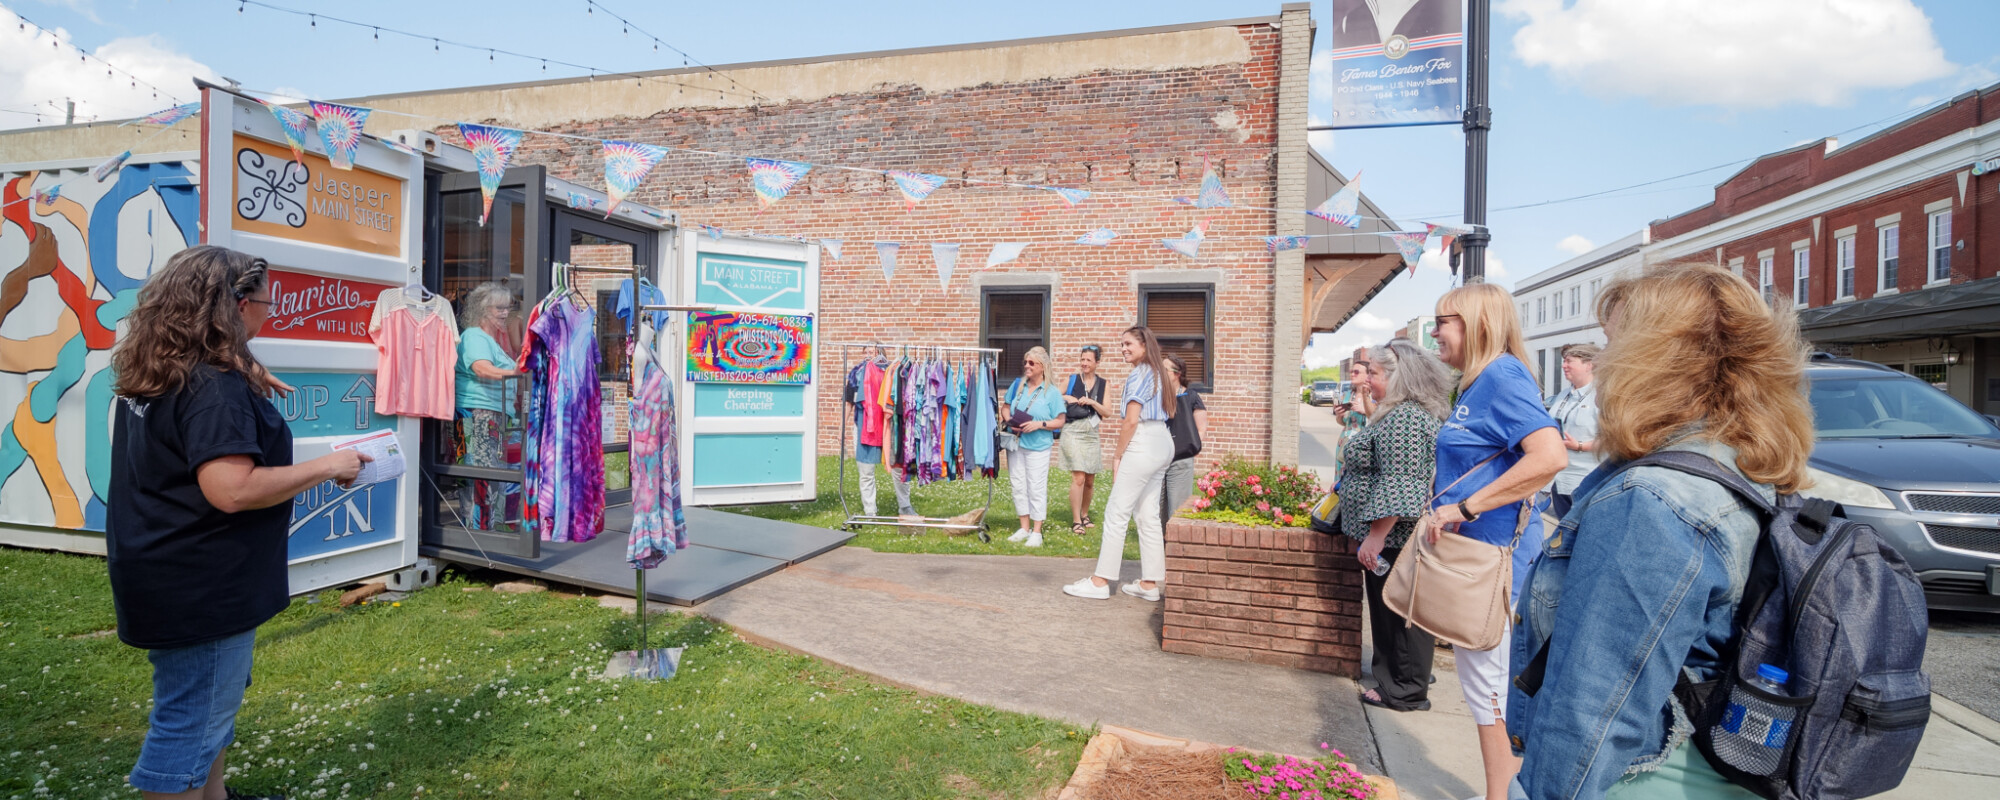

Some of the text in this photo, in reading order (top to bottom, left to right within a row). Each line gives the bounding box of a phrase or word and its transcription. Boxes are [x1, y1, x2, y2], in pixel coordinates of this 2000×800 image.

[1341, 58, 1452, 83] James Benton Fox
[1406, 79, 1425, 90] Navy
[1426, 76, 1458, 86] Seabees
[313, 172, 391, 209] Jasper
[312, 197, 395, 233] MAIN STREET
[714, 266, 792, 285] MAIN STREET
[267, 279, 360, 318] lourish
[316, 319, 366, 336] WITH US
[738, 313, 808, 328] 205-674-0838
[268, 385, 330, 422] OP
[724, 399, 775, 410] Character
[728, 388, 773, 402] Keeping
[322, 484, 375, 541] IN
